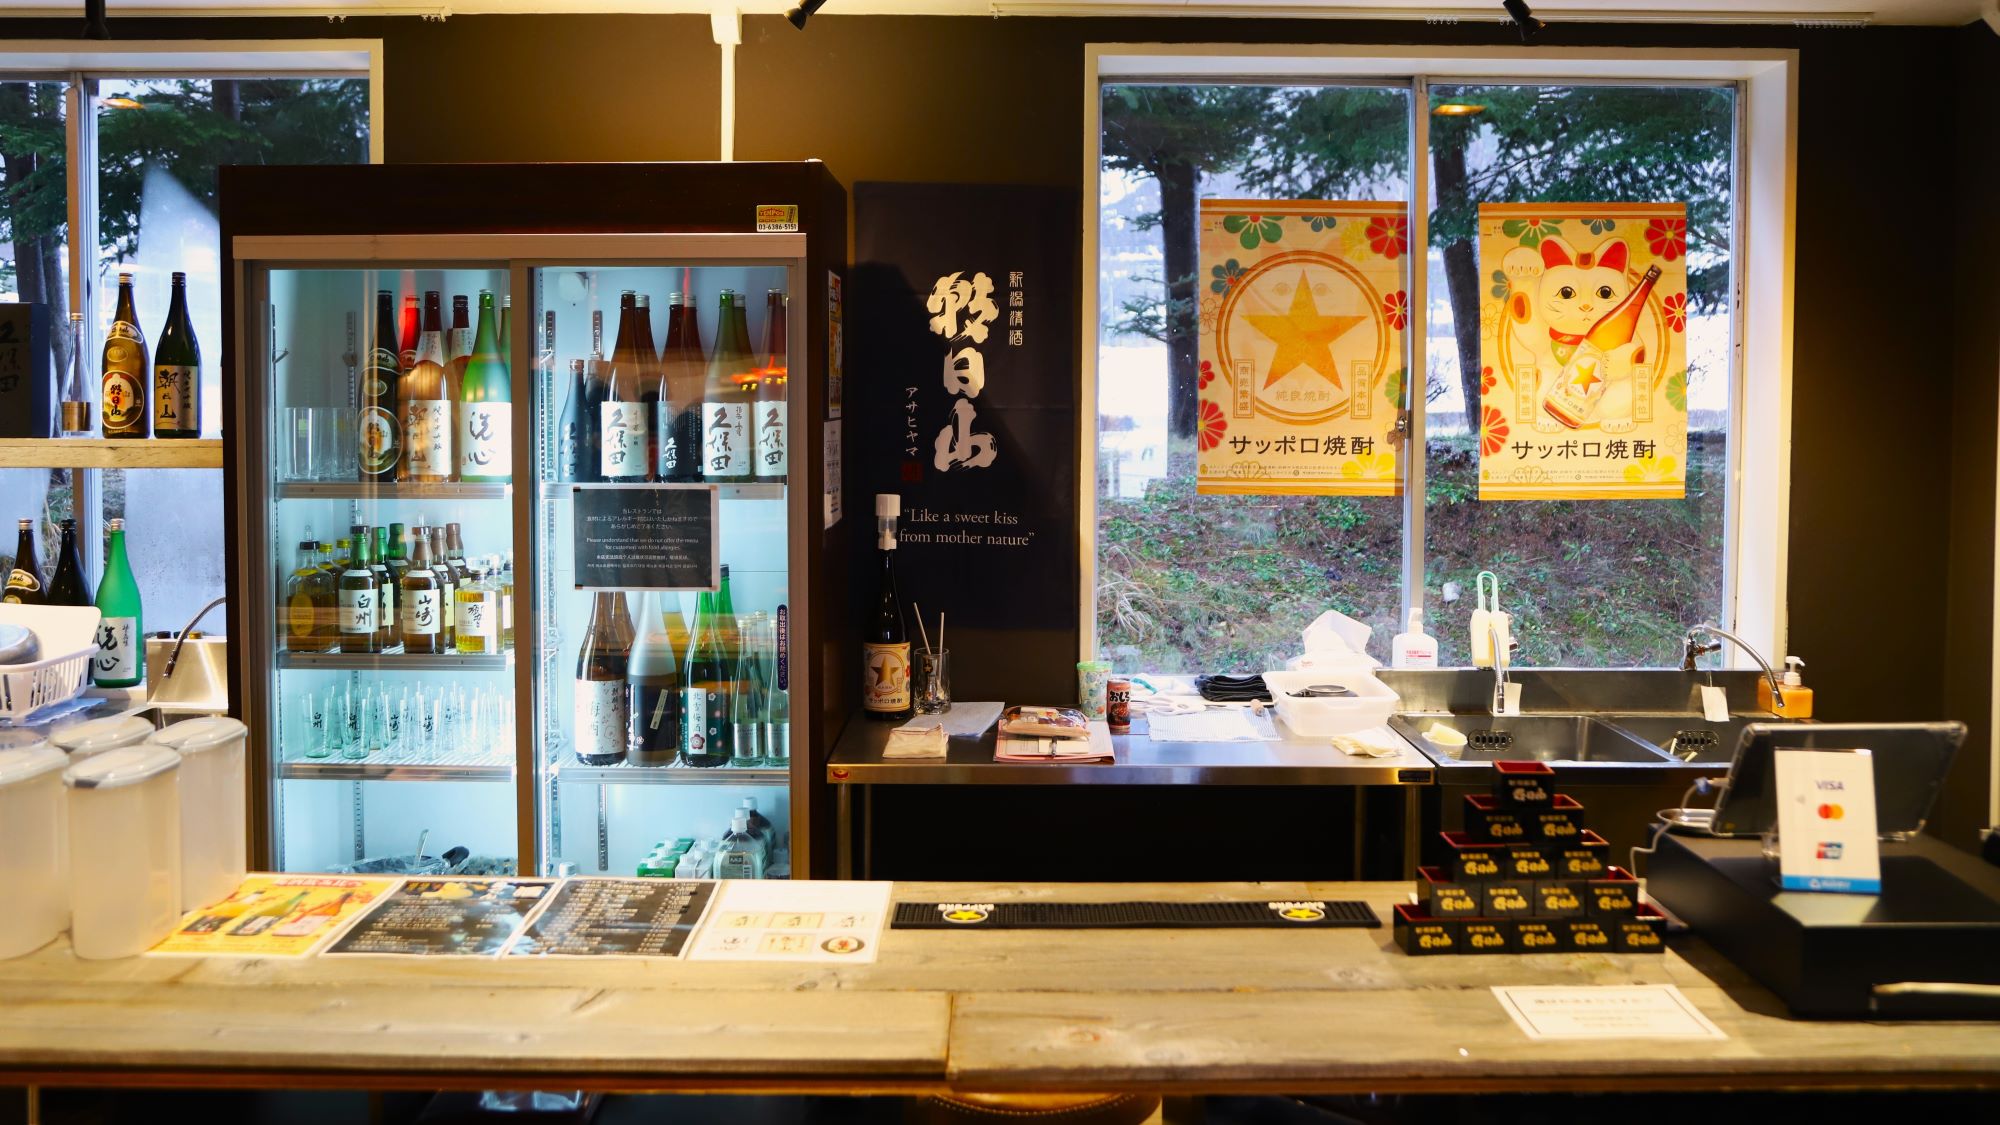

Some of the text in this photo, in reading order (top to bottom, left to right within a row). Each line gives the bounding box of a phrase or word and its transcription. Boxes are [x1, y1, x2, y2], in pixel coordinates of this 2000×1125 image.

[608, 408, 627, 464] 久保田
[759, 408, 784, 466] 久保田
[905, 387, 919, 456] アサヒヤマ
[663, 437, 677, 469] 久保田
[706, 407, 732, 471] 久保田
[1229, 435, 1375, 456] サッポロ焼酎
[1511, 439, 1656, 460] サッポロ焼酎
[943, 513, 950, 522] a
[954, 511, 990, 523] sweet
[994, 509, 1018, 525] kiss
[900, 528, 931, 544] from
[935, 529, 983, 545] mother
[356, 594, 371, 627] 白州
[416, 594, 432, 627] 山崎
[1816, 781, 1844, 791] VISA
